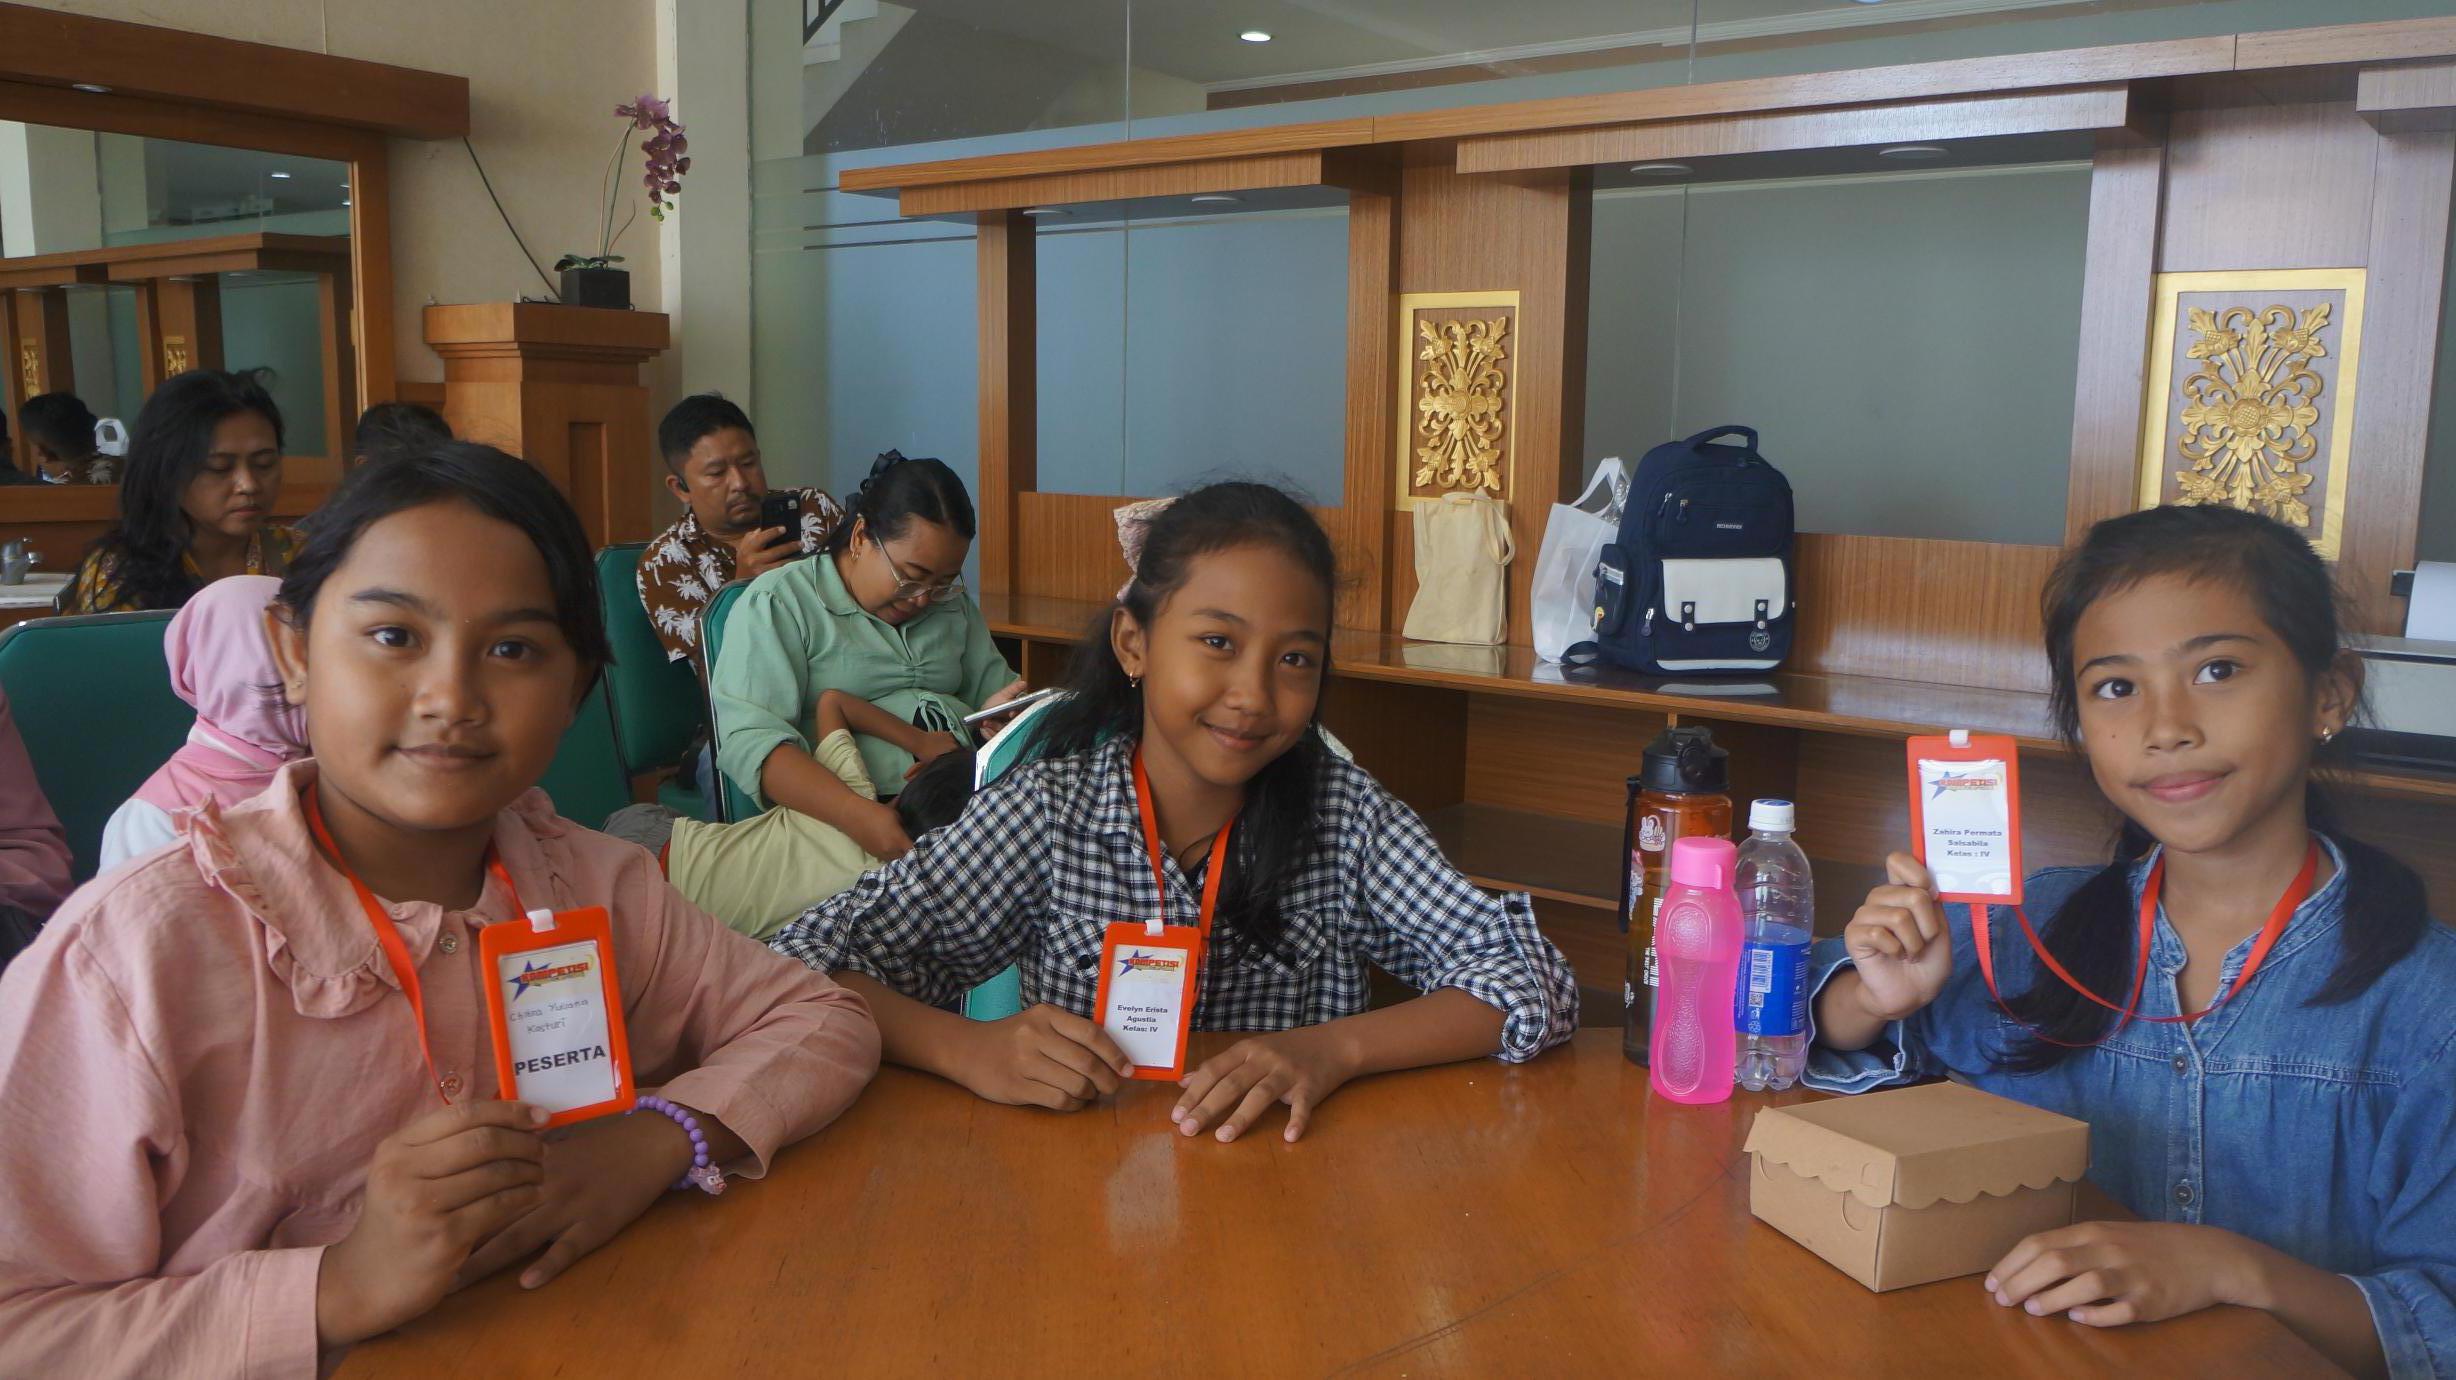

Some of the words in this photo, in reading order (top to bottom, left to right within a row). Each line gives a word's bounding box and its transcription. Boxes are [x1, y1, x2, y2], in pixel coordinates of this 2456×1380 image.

[1964, 829, 2002, 837] Permata
[1117, 1004, 1143, 1013] Evelyn
[514, 1045, 607, 1077] PESERTA
